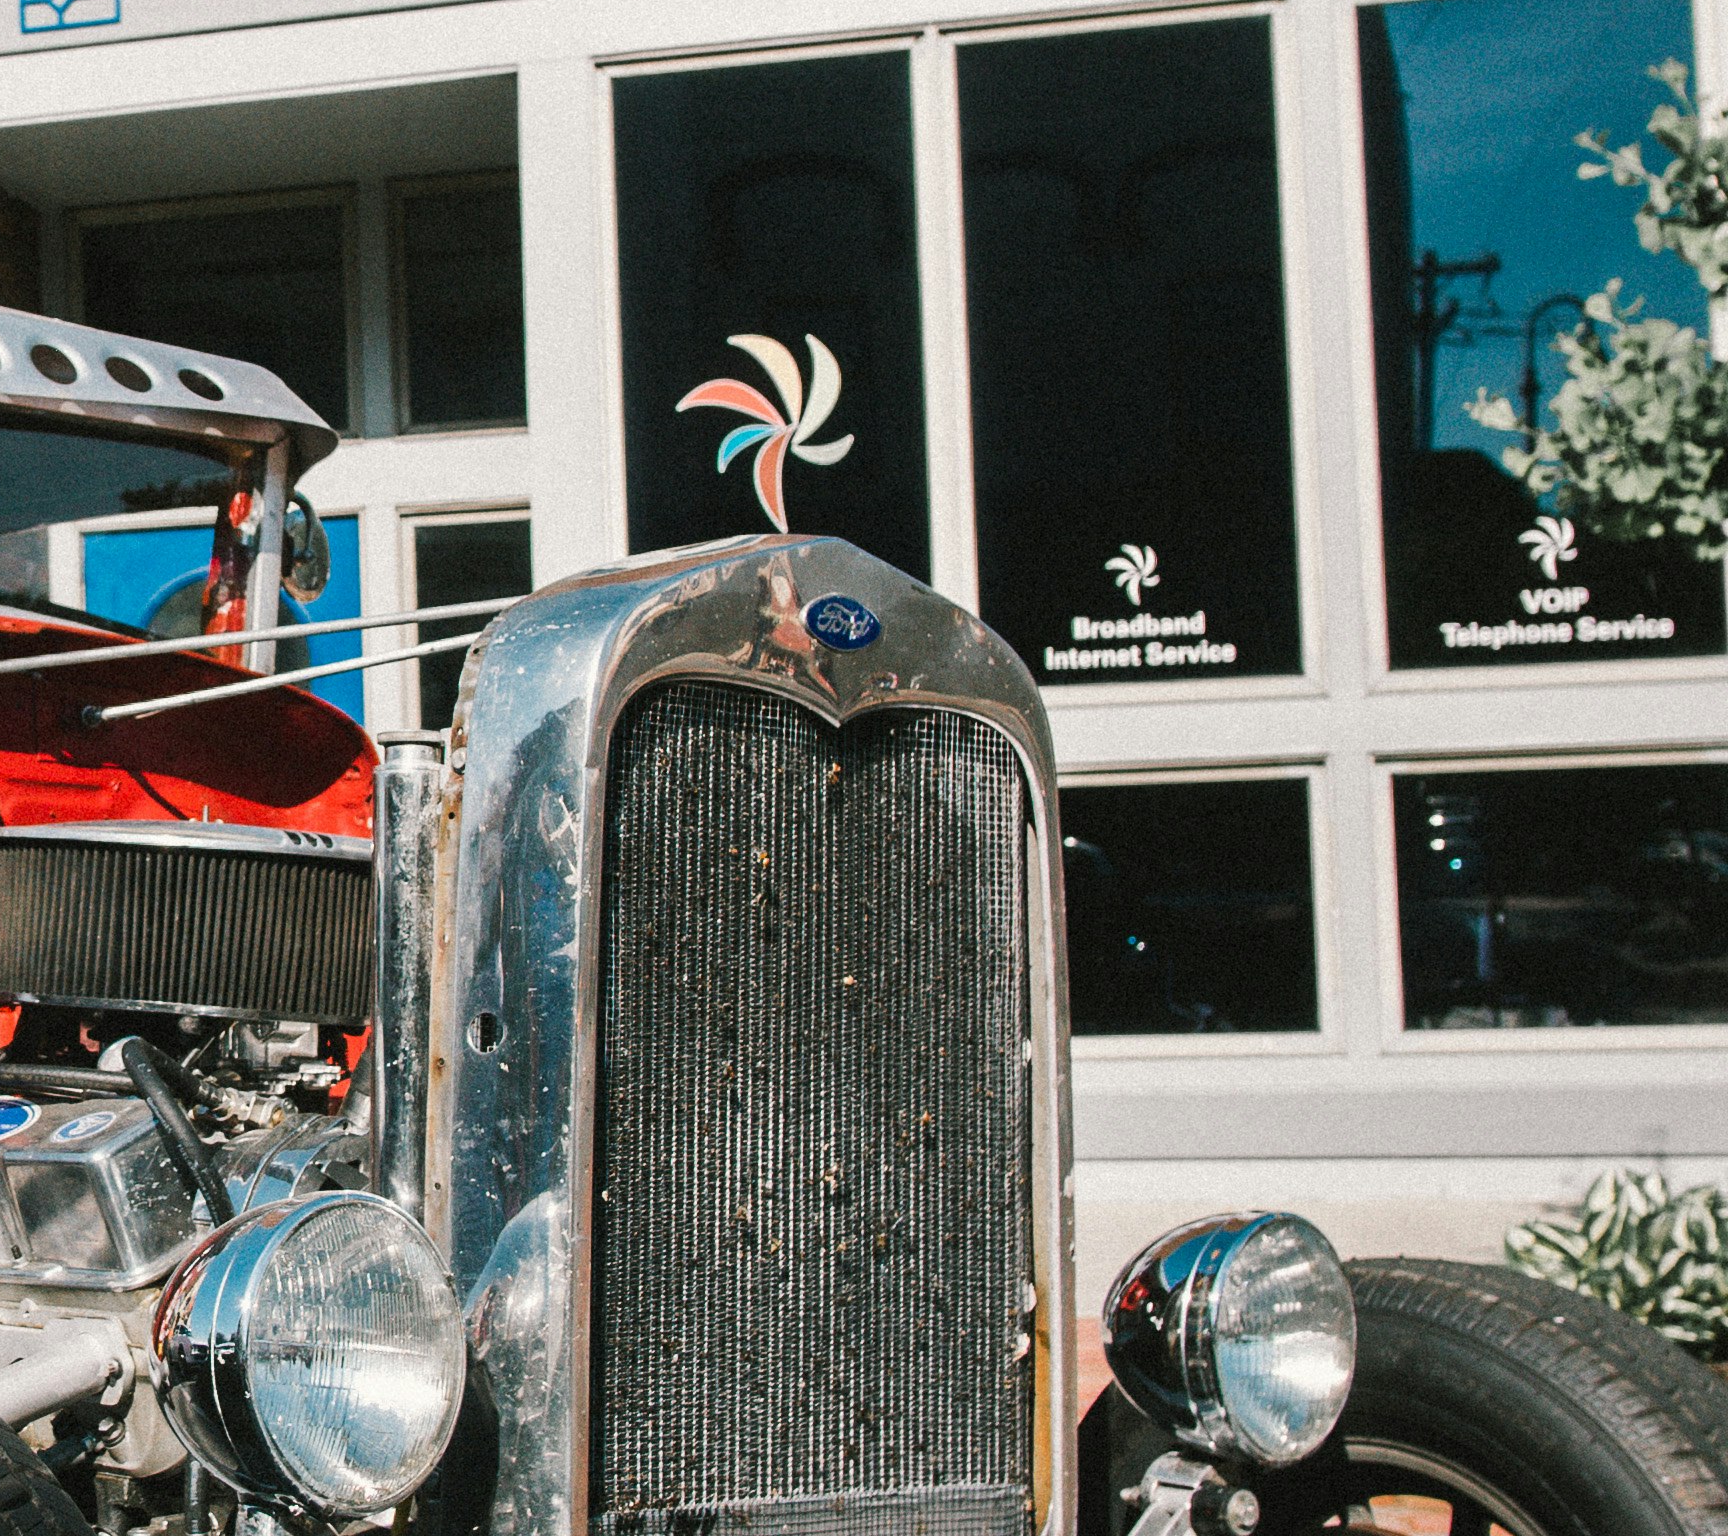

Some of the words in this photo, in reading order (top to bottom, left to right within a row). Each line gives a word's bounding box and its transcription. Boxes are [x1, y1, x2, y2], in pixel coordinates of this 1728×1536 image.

[1520, 587, 1590, 614] VOIP
[817, 602, 870, 640] Ford
[1072, 610, 1205, 640] Broadband
[1440, 620, 1573, 650] Telephone
[1576, 614, 1674, 642] Service
[1044, 645, 1142, 670] Internet
[1145, 639, 1237, 666] Service
